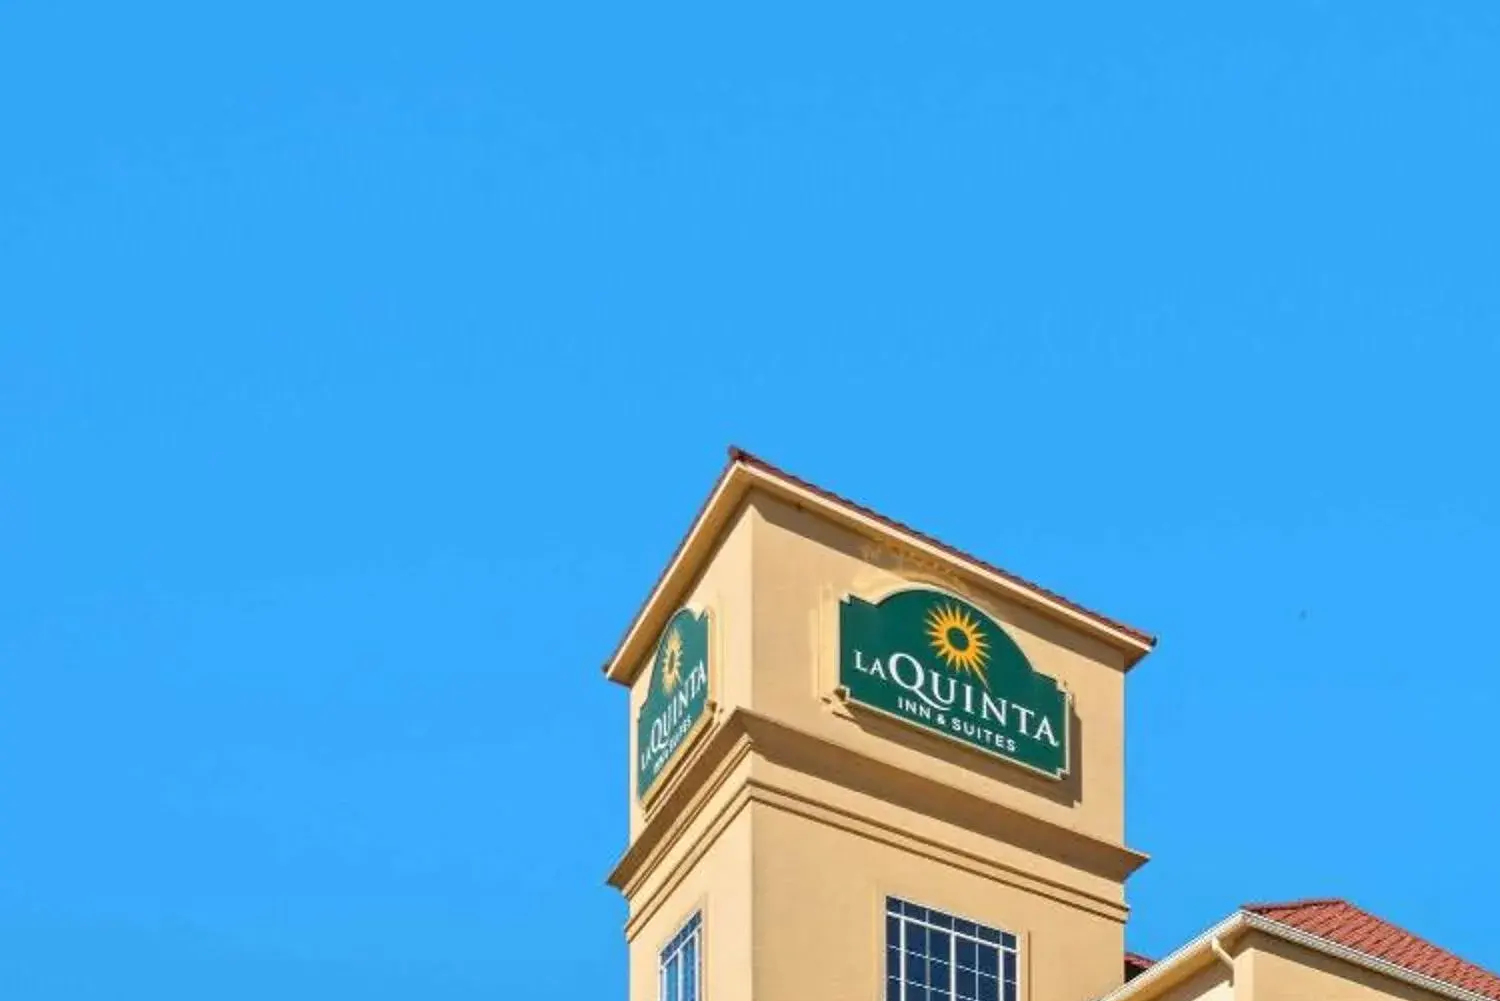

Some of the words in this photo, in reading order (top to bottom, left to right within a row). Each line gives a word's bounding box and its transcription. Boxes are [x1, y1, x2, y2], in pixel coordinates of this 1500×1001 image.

[651, 659, 708, 752] QUINTA
[854, 650, 888, 680] LA
[889, 653, 1060, 747] QUINTA
[897, 696, 932, 720] INN
[937, 713, 947, 725] &
[952, 717, 1017, 752] SUITES
